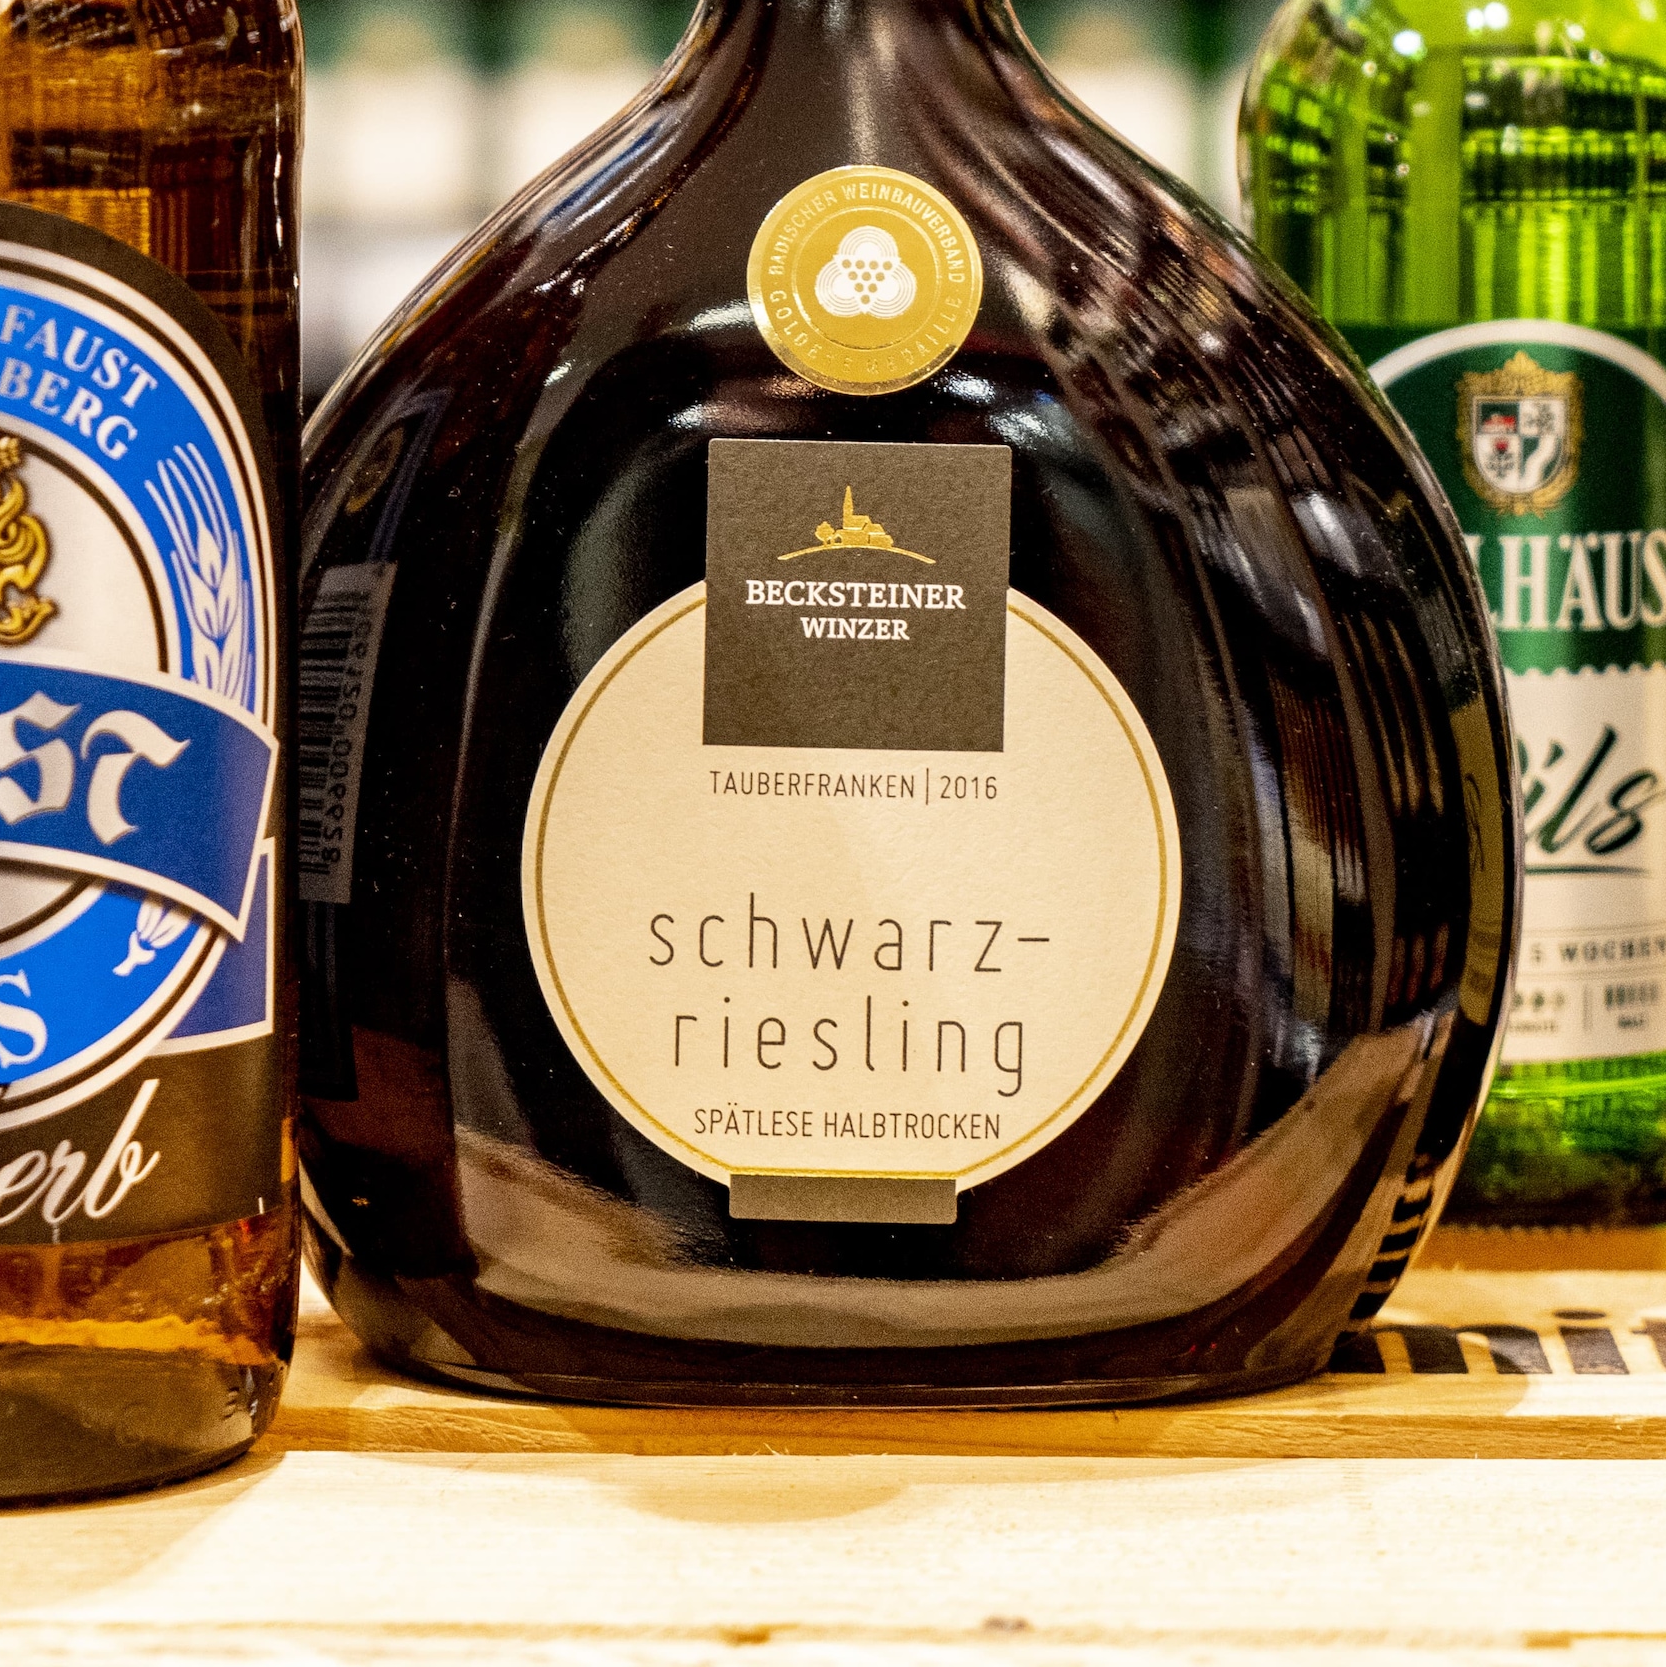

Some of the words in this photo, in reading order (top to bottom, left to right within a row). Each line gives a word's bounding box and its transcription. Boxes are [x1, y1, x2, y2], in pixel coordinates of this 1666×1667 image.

[768, 190, 838, 276] BADISCHER
[841, 182, 966, 283] WEINBAUVERBAND
[0, 304, 159, 410] FAUST
[770, 290, 852, 375] GOLDEE
[745, 579, 967, 611] BECKSTEINER
[800, 616, 910, 640] WINZER
[709, 770, 915, 798] TAUBERFRANKEN
[939, 775, 998, 800] 2016
[648, 892, 1050, 973] schwarz-
[673, 995, 1024, 1098] riesling
[694, 1103, 814, 1138] SPÄTLESE
[823, 1112, 1001, 1140] HALBTROCKEN
